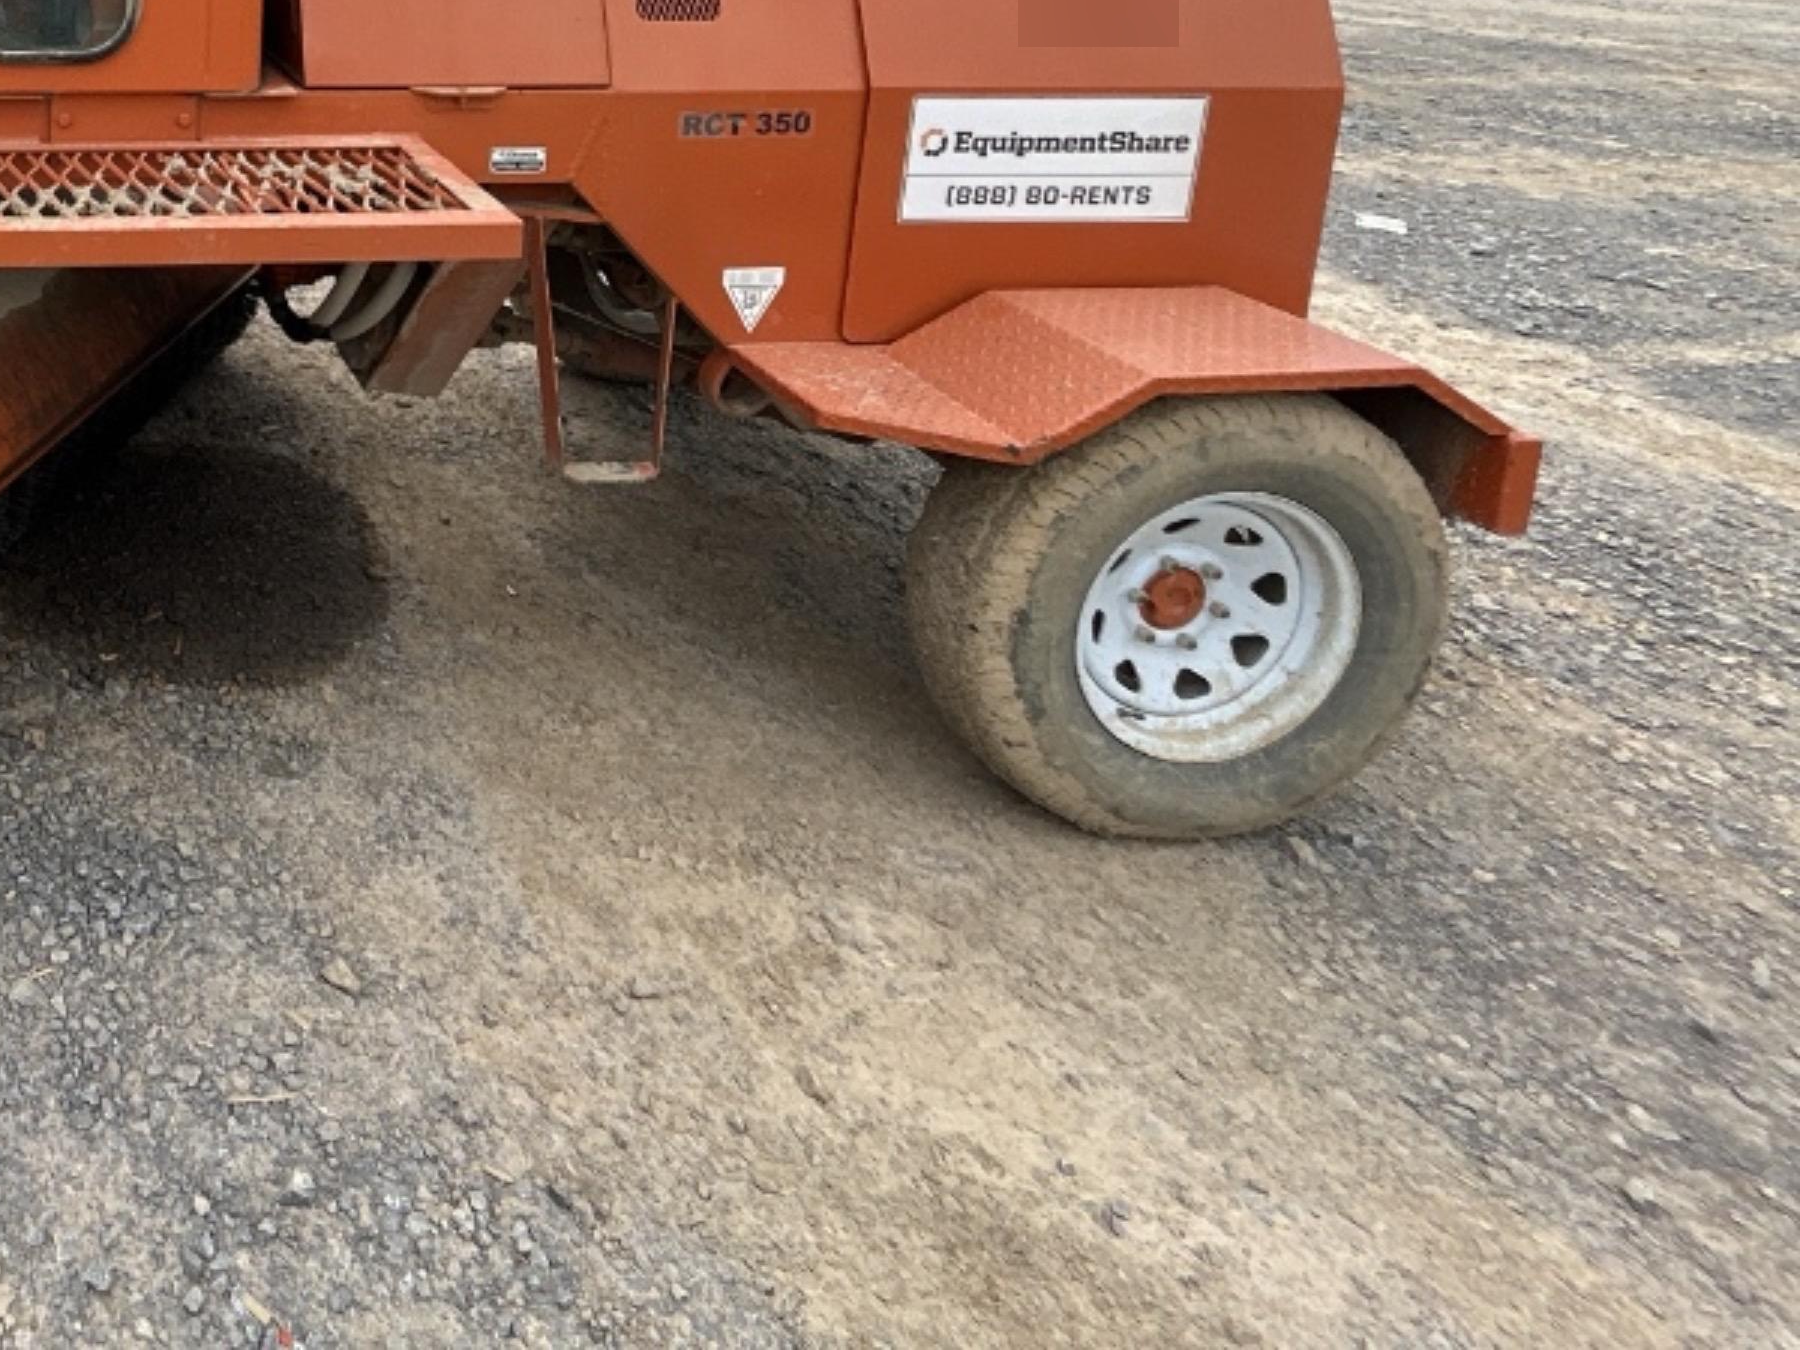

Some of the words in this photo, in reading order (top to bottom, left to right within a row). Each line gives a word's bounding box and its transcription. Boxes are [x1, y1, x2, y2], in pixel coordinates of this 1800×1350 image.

[681, 113, 746, 136] RCT
[756, 110, 811, 135] 350
[953, 130, 1190, 158] EquipmentShare
[1026, 185, 1151, 206] 80-RENTS
